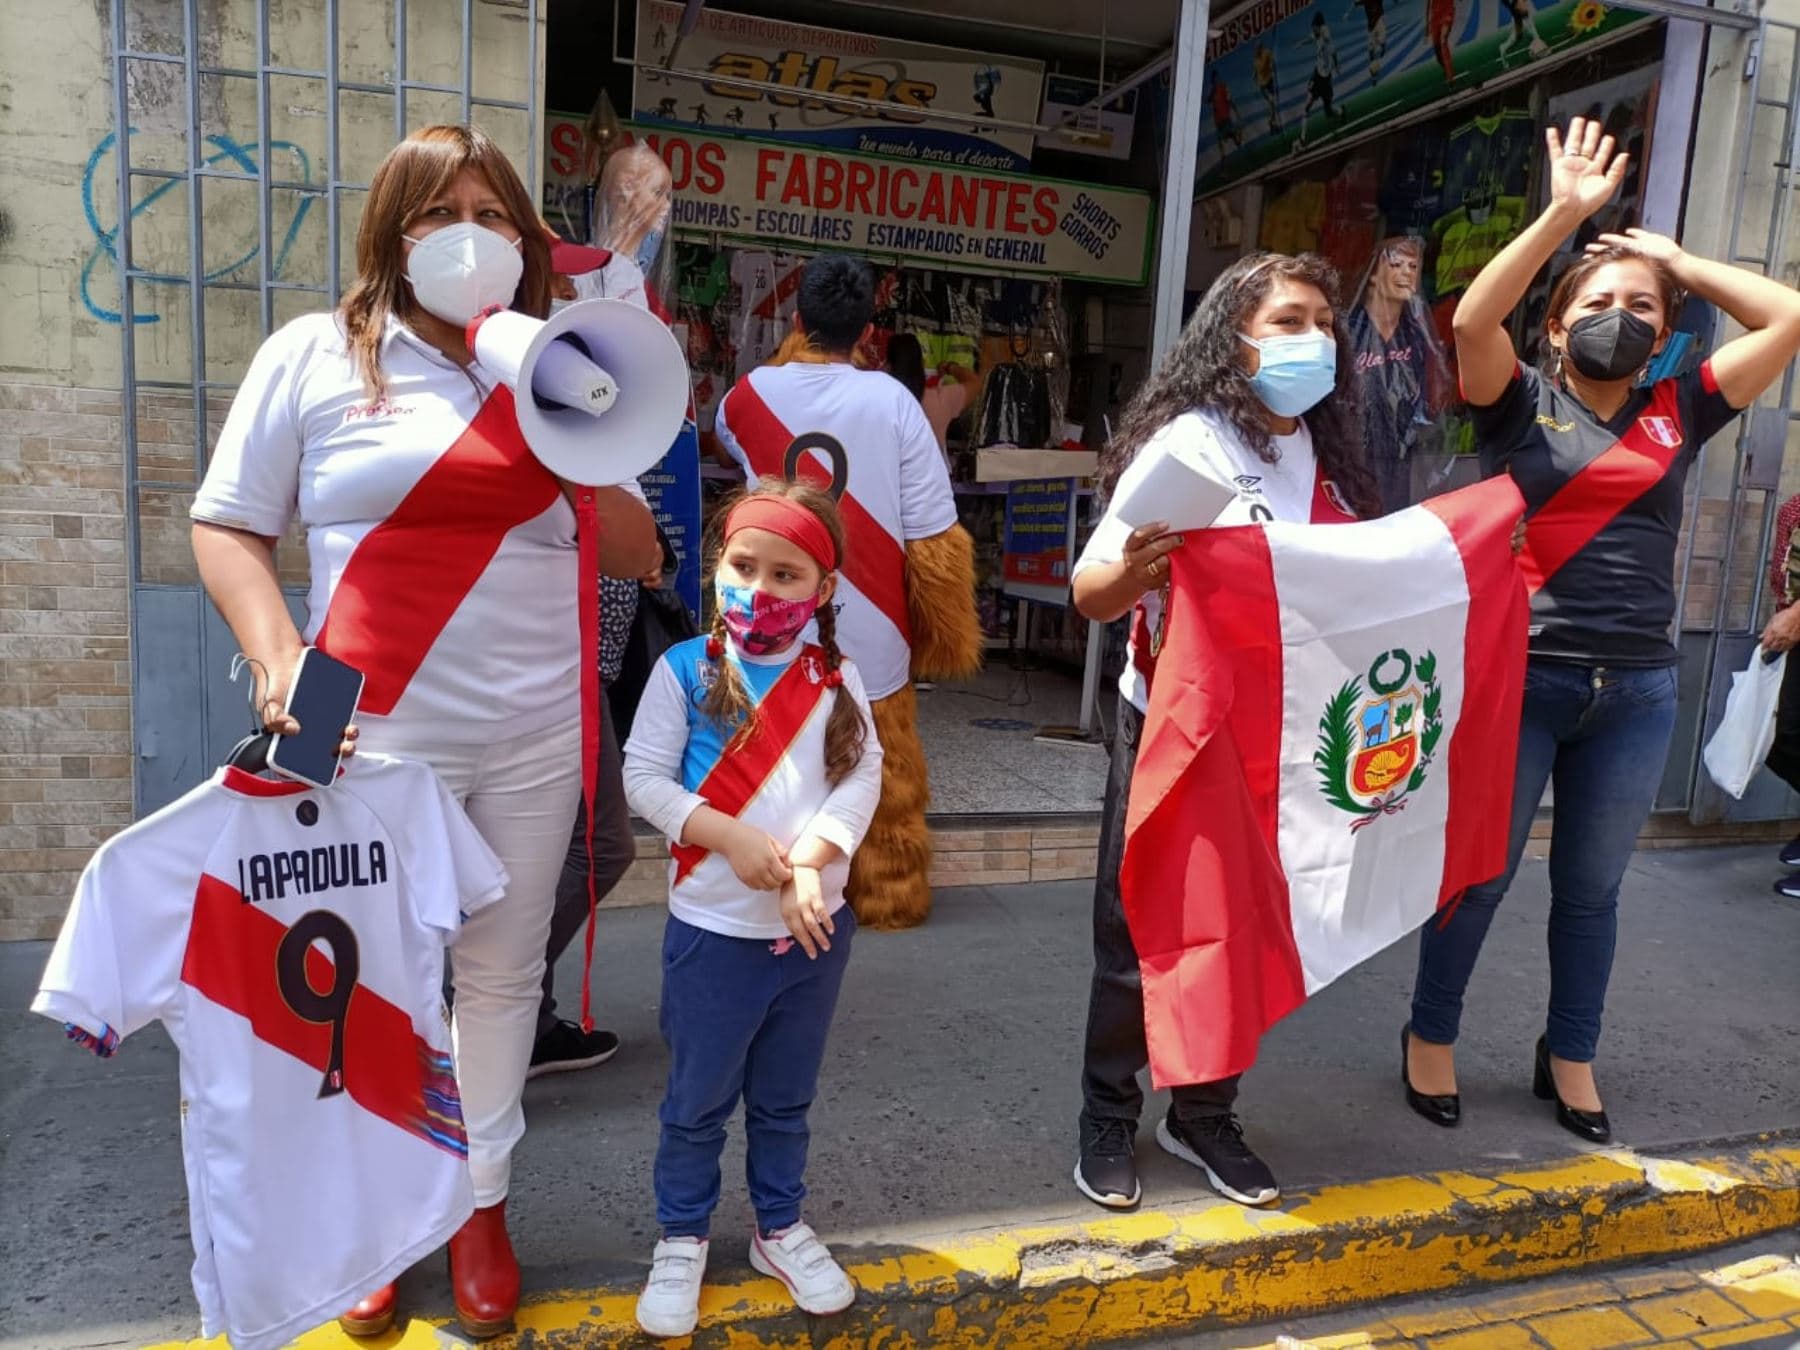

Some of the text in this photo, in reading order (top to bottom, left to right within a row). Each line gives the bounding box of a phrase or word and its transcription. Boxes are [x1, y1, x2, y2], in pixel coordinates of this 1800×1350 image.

[706, 50, 937, 124] atlas
[551, 123, 1060, 237] SOS FABRICANTES
[878, 140, 917, 158] mundo
[921, 146, 953, 162] para
[955, 147, 970, 164] el
[970, 152, 1015, 170] deporte
[672, 199, 740, 229] HOMPAS
[756, 209, 852, 242] ESCOLARES
[867, 223, 964, 256] ESTAMPADOS
[967, 237, 982, 252] EN
[985, 237, 1047, 265] GENERAL
[1060, 213, 1109, 261] GORROS
[1072, 192, 1121, 241] SHORTS
[591, 386, 608, 401] ATK
[239, 840, 388, 904] LAPADULA
[276, 908, 360, 1101] 9
